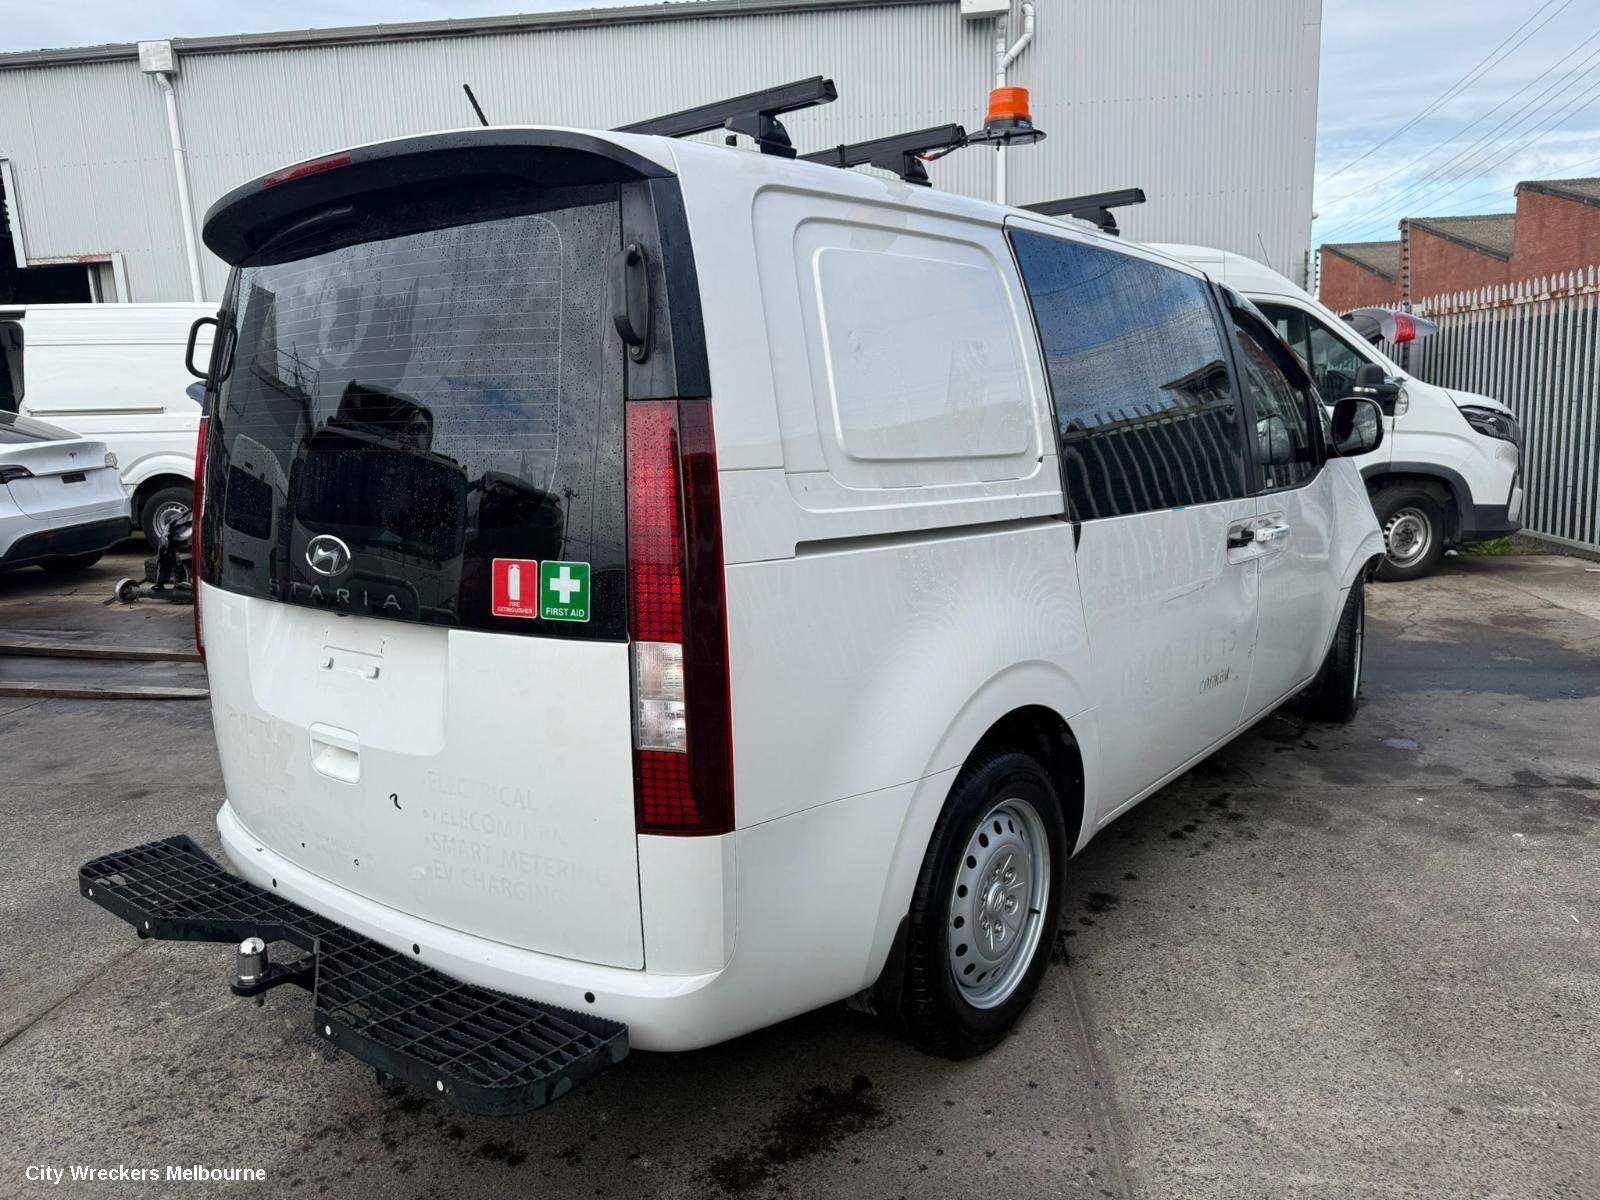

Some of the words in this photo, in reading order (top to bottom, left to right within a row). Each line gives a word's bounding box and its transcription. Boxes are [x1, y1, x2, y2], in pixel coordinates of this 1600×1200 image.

[268, 577, 401, 611] STARIA
[545, 607, 569, 616] FIRST
[570, 608, 585, 617] AID
[431, 831, 493, 865] SMART
[433, 858, 454, 881] EV
